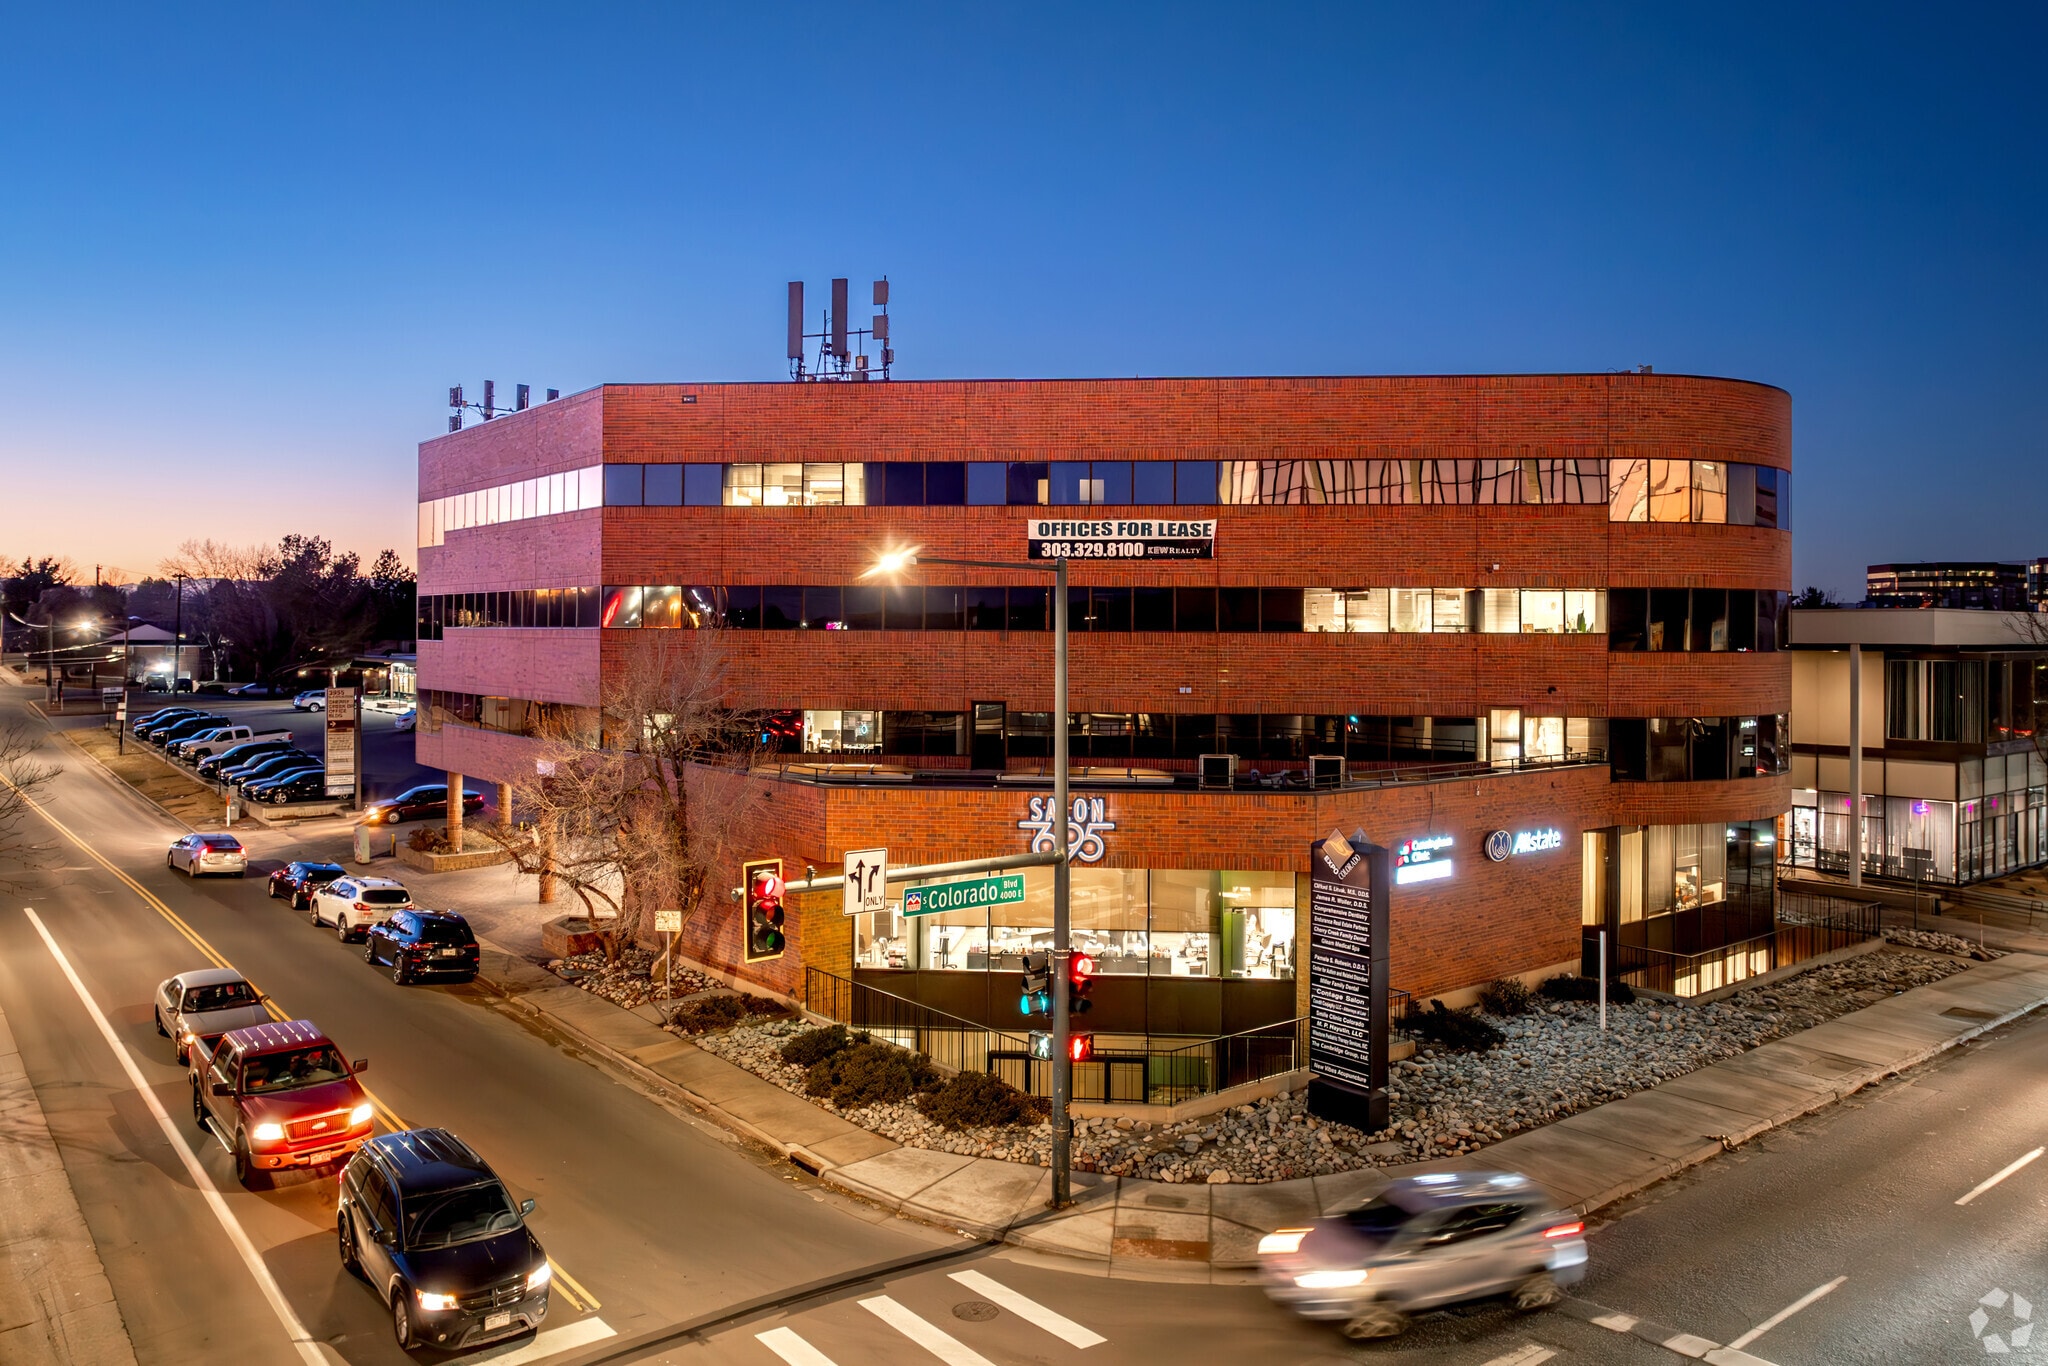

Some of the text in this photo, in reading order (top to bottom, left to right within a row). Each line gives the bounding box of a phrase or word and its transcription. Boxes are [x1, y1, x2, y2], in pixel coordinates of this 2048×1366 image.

[1038, 522, 1212, 537] OFFICES FOR LEASE
[1041, 542, 1144, 557] 303.329.8100
[1030, 797, 1104, 822] SAON
[1512, 828, 1561, 854] Allstate
[1324, 855, 1339, 874] EXPO
[1338, 854, 1360, 880] COLORADO
[1004, 879, 1018, 888] Blvd
[866, 896, 884, 906] ONLY
[923, 883, 998, 909] S Colorado
[1000, 890, 1016, 900] 4000
[1314, 905, 1368, 921] Comprehensive Dentistry
[1314, 926, 1327, 934] Cherry
[1340, 932, 1353, 940] Family
[1353, 924, 1368, 932] Partners
[1335, 941, 1351, 949] Medical
[1314, 954, 1329, 962] Pamela
[1354, 974, 1368, 982] Disorders
[1332, 981, 1345, 990] Family
[1345, 984, 1359, 992] Dental
[1346, 996, 1364, 1005] Salon
[1316, 1010, 1364, 1028] Smile Clinic Colorado
[1321, 1043, 1343, 1054] Cambridge
[1344, 1050, 1359, 1059] Group,
[1325, 1065, 1336, 1074] Vibes
[1337, 1070, 1367, 1083] Acupuncture
